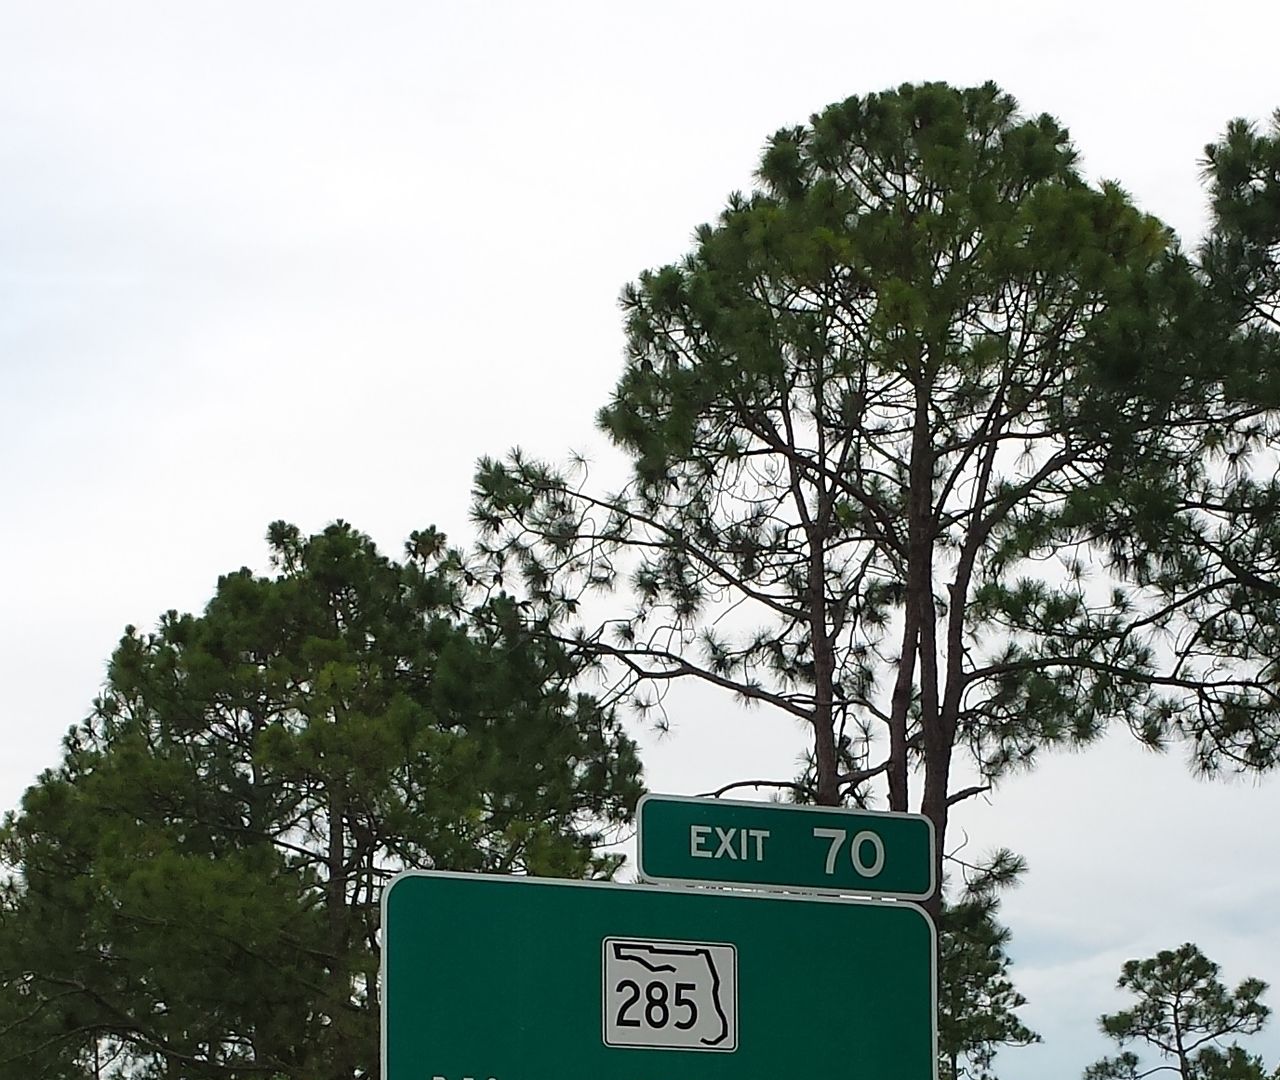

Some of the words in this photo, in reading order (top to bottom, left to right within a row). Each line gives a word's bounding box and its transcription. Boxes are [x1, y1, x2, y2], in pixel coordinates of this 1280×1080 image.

[690, 825, 770, 861] EXIT
[813, 828, 885, 878] 70
[615, 980, 699, 1030] 285
